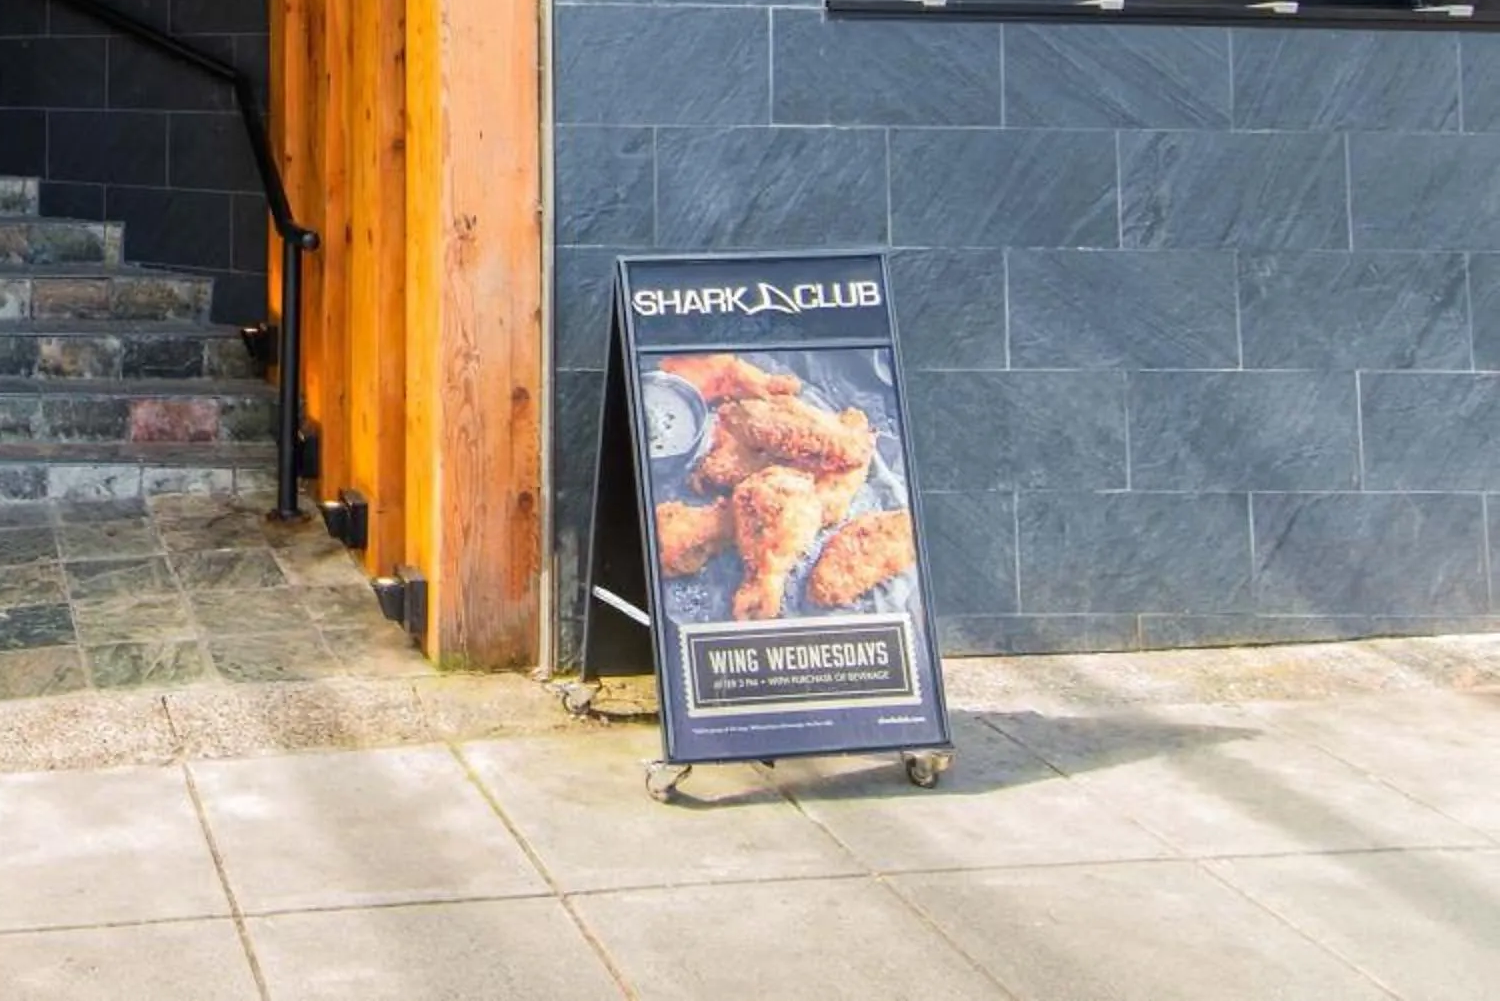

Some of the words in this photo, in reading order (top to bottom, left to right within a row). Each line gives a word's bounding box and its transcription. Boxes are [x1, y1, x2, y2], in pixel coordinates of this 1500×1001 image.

[632, 287, 749, 315] SHARK
[794, 282, 881, 308] CLUB
[708, 649, 760, 674] WING
[766, 641, 890, 671] WEDNESDAYS
